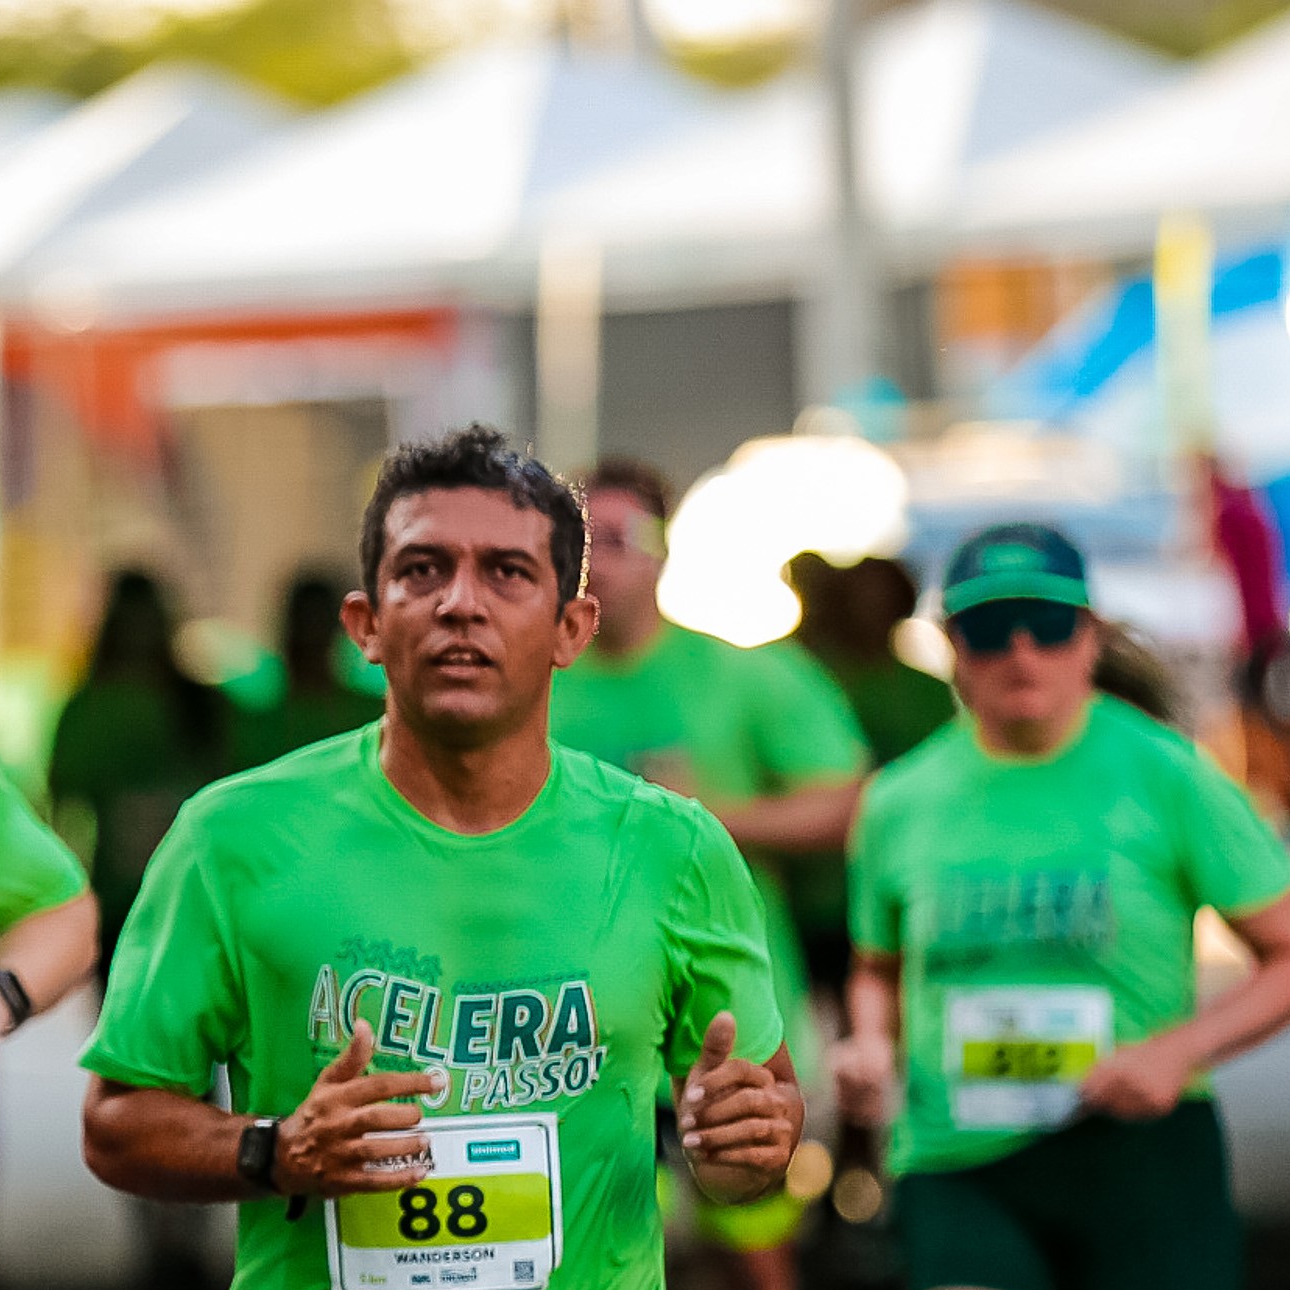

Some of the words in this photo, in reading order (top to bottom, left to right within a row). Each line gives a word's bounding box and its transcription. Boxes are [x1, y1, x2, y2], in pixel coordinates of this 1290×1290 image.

[310, 964, 598, 1068] ACELERA
[459, 1046, 607, 1111] PASSO!
[398, 1184, 488, 1242] 88
[394, 1248, 496, 1265] WANDERSON
